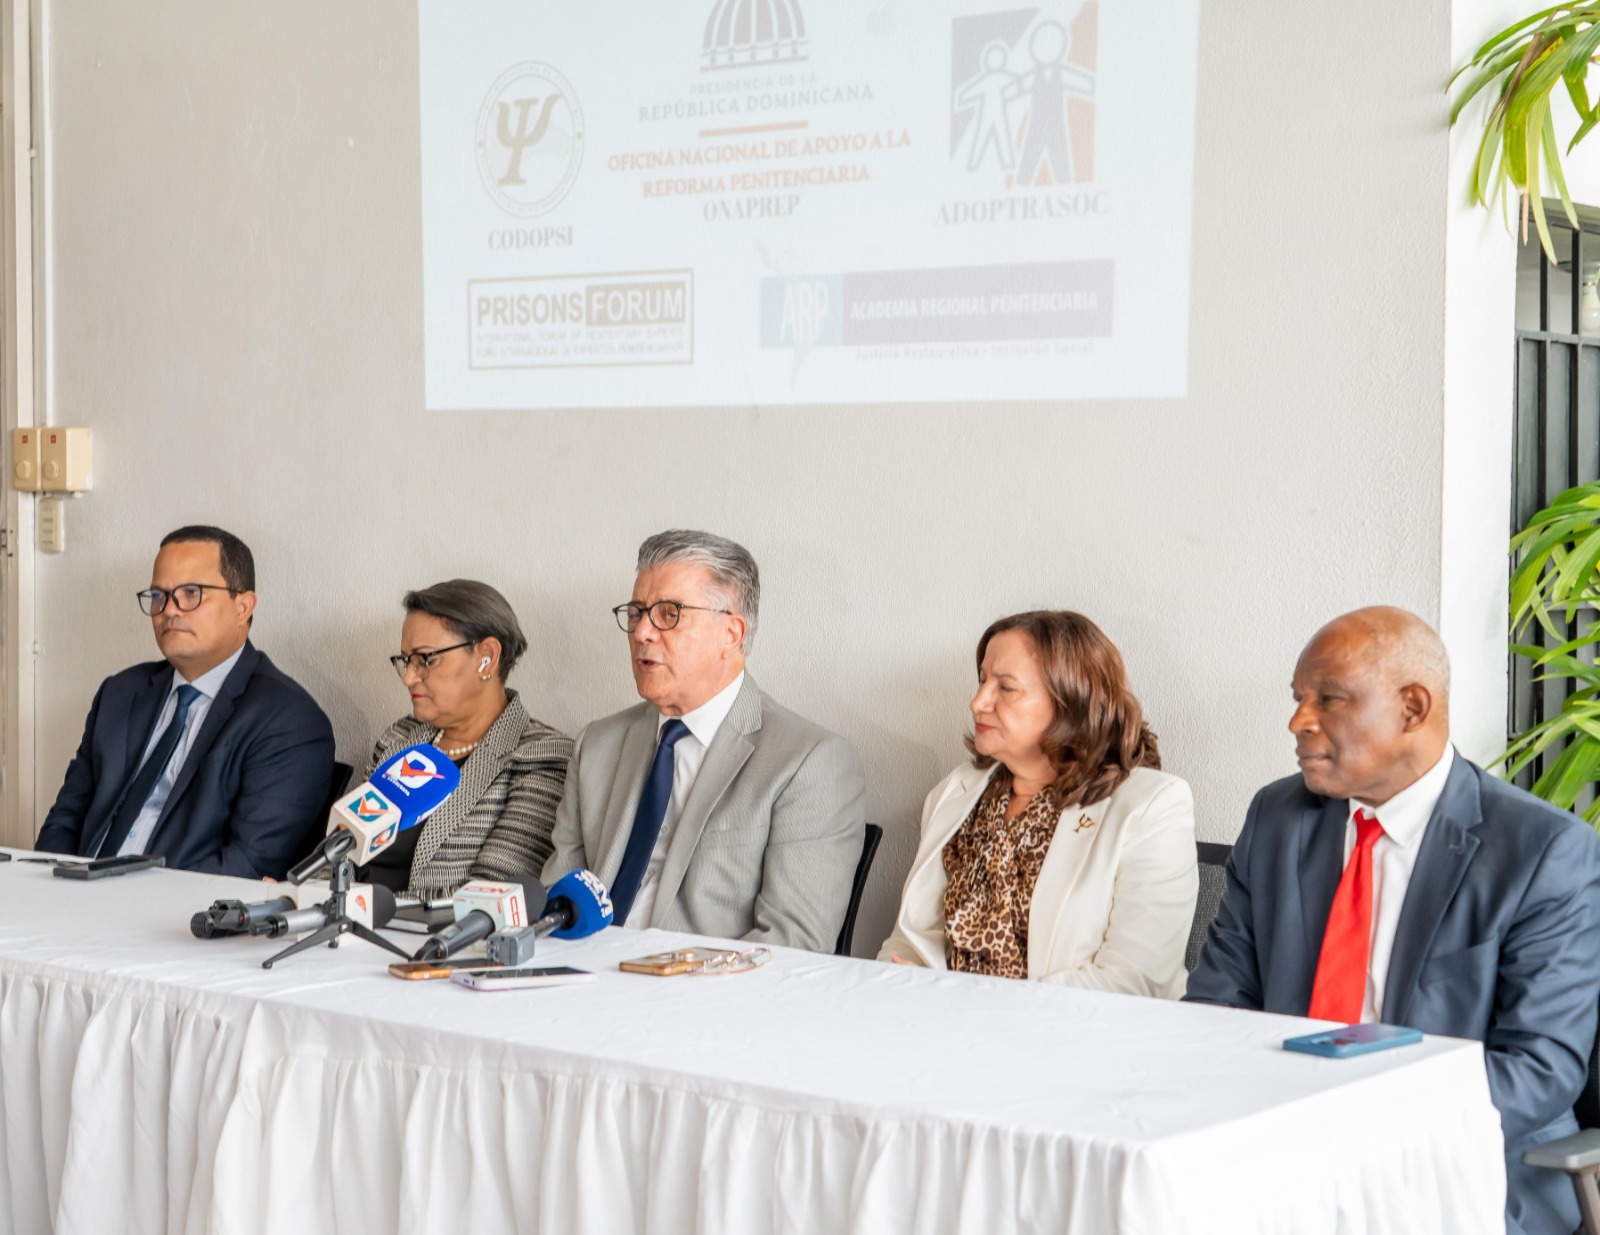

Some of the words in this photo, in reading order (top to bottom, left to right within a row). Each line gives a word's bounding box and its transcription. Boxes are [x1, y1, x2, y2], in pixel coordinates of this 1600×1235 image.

[690, 76, 774, 95] PRESIDENCIA
[779, 74, 795, 88] DE
[801, 72, 817, 84] LA
[638, 98, 740, 122] REPÚBLICA
[746, 84, 874, 112] DOMINICANA
[608, 150, 675, 172] OFICINA
[679, 142, 771, 168] NACIONAL
[774, 138, 798, 159] DE
[802, 132, 867, 155] APOYO
[870, 131, 883, 149] A
[886, 129, 911, 148] LA
[643, 176, 726, 198] REFORMA
[730, 163, 870, 191] PENITENCIARIA
[703, 194, 800, 221] ONAPREP
[935, 190, 1109, 225] ADOPTRASOC
[488, 225, 574, 250] CODOPSI
[476, 292, 584, 327] PRISONS
[591, 287, 683, 321] FORUM
[780, 279, 829, 341] ARP
[850, 301, 918, 319] ACADEMIA
[921, 296, 987, 317] REGIONAL
[990, 291, 1098, 314] PENITENCIARIA
